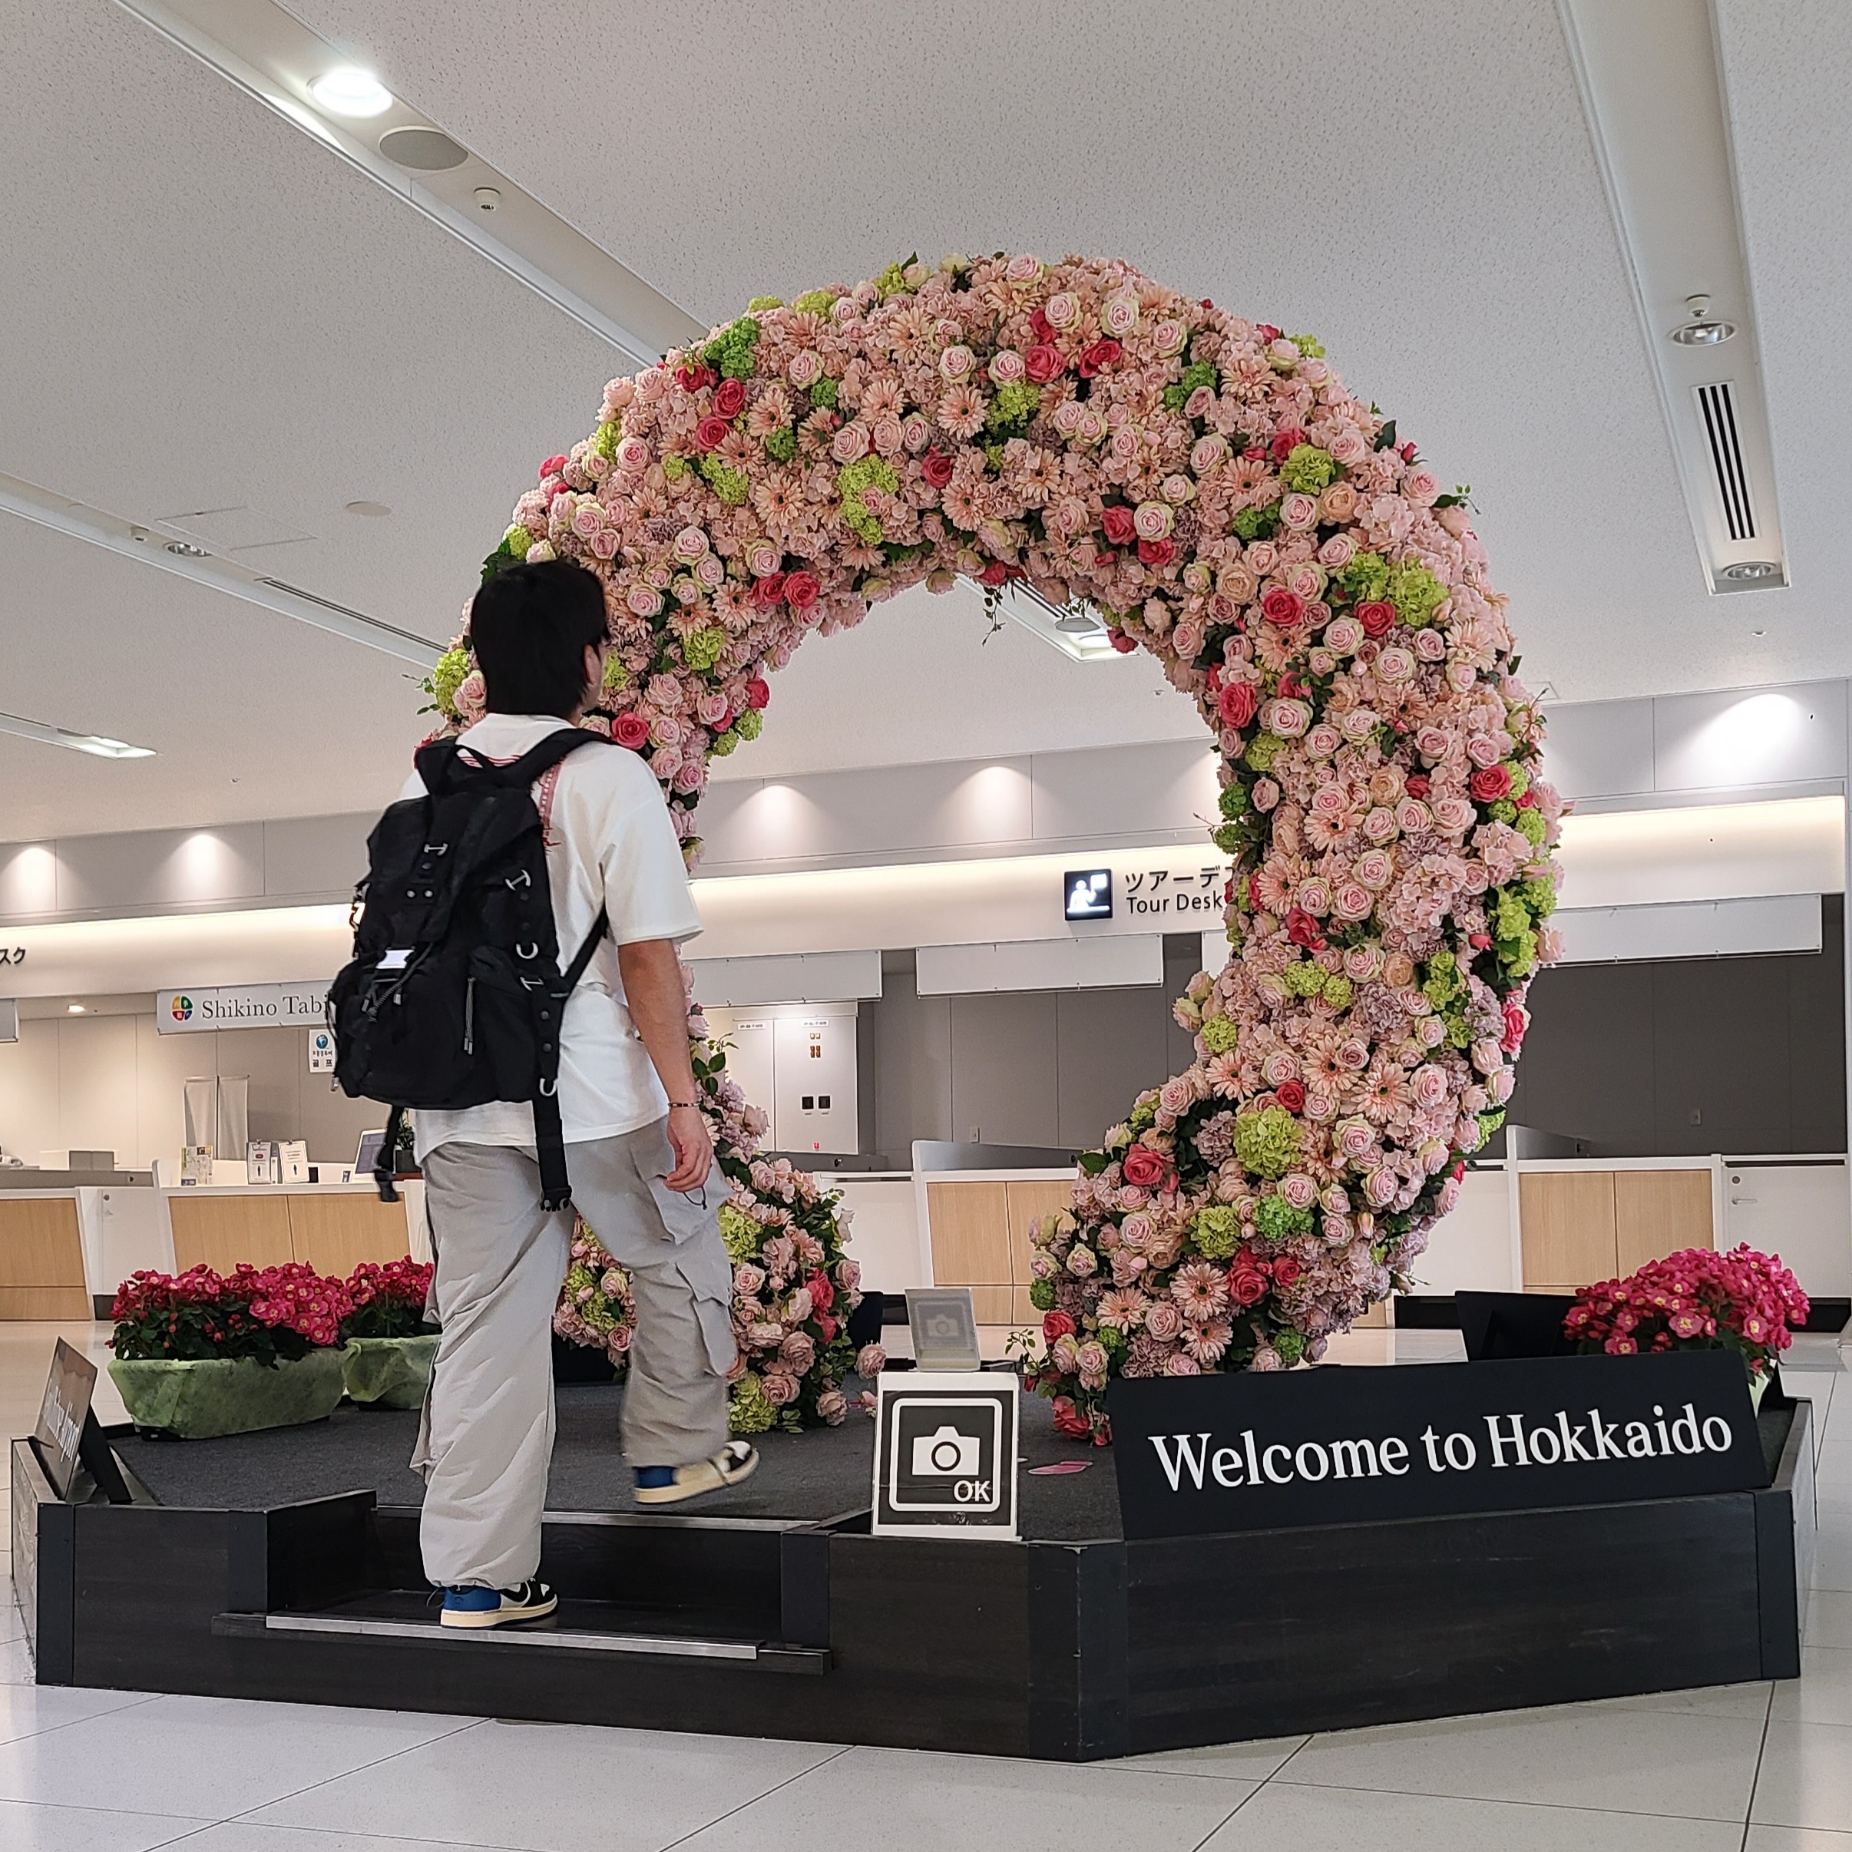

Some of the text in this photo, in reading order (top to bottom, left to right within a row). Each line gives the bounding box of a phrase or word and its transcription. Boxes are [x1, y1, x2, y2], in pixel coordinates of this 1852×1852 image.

[1126, 890, 1223, 914] Tour Desk
[202, 998, 277, 1019] Shikino
[1147, 1403, 1733, 1492] Welcome to Hokkaido
[953, 1480, 991, 1502] OK
